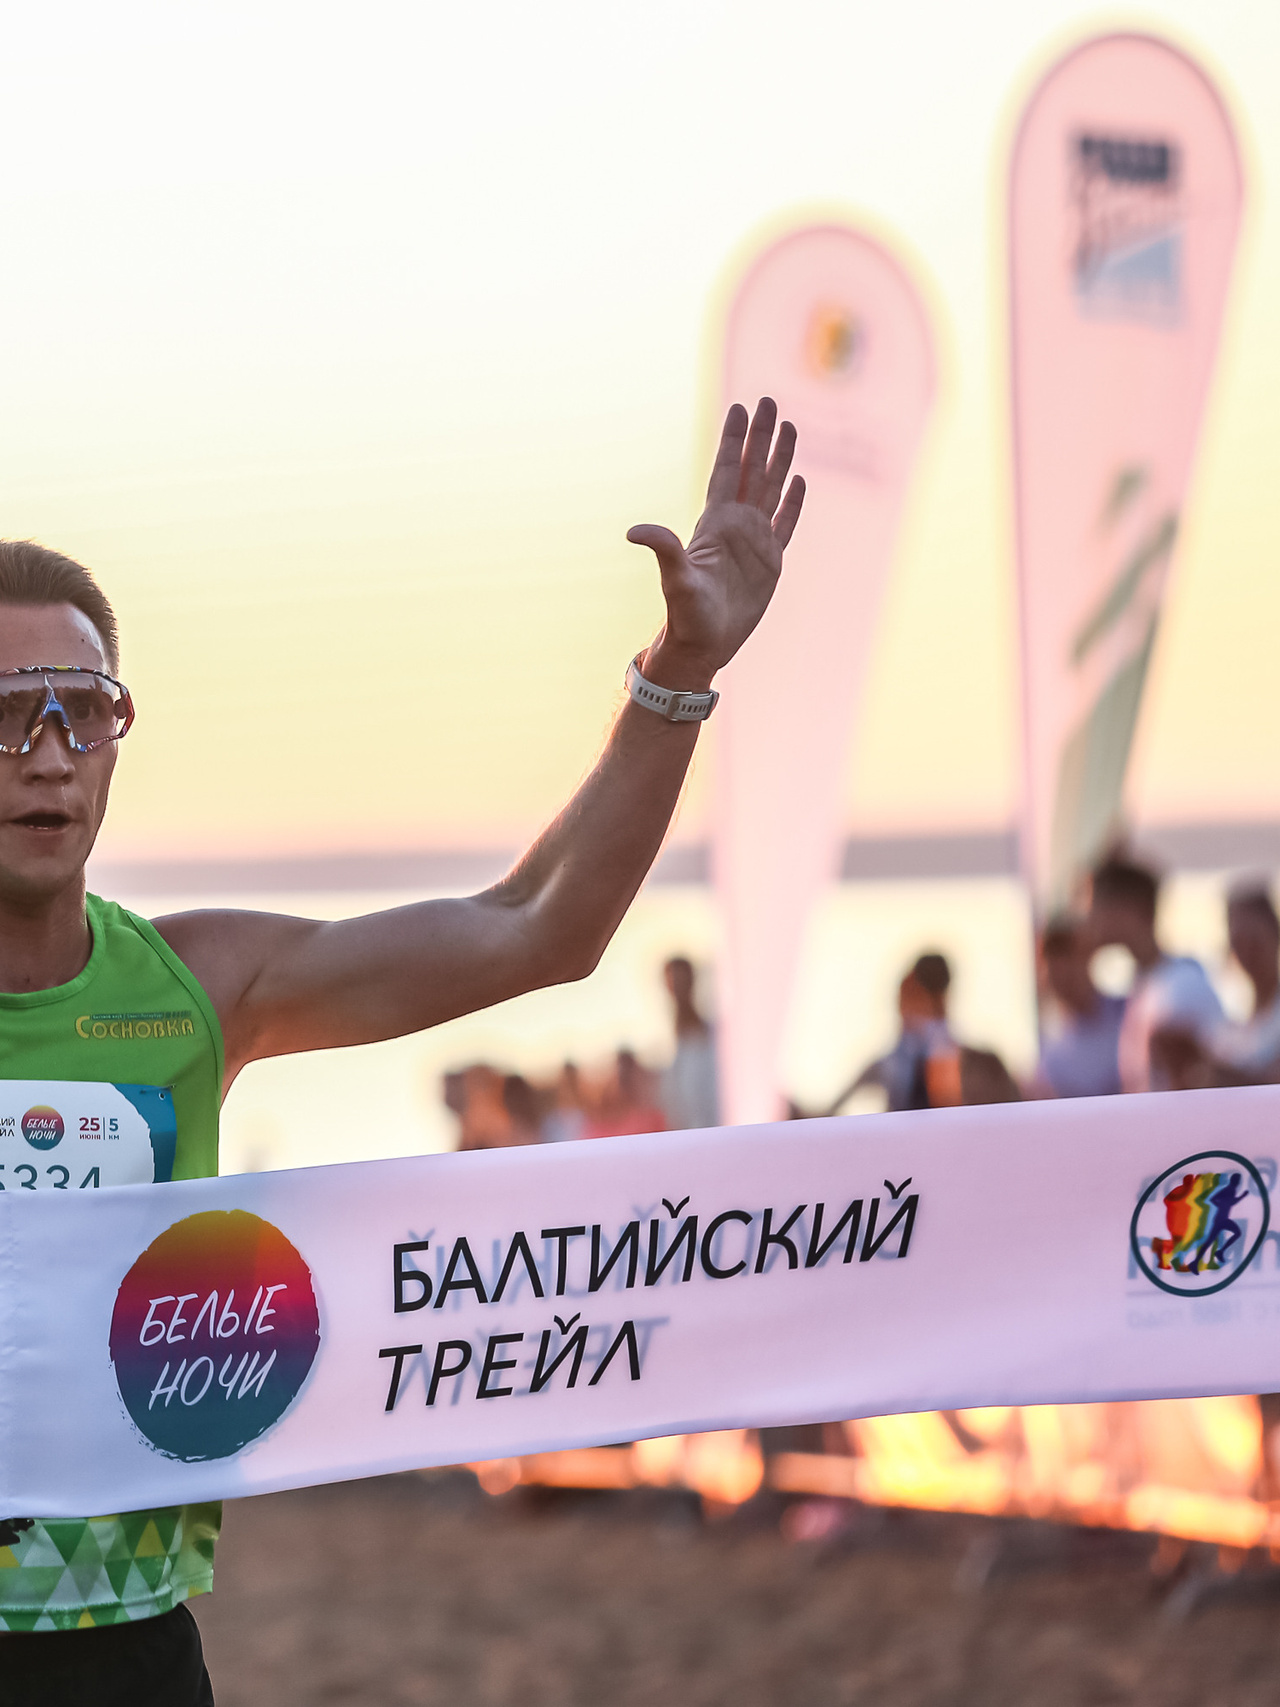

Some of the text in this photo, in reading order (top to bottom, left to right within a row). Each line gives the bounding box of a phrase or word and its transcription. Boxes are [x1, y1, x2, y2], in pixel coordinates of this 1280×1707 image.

[26, 1118, 58, 1129] БЕЛЫЕ
[28, 1130, 57, 1140] НОЧИ
[79, 1117, 101, 1132] 25
[109, 1118, 119, 1132] 5
[393, 1177, 920, 1314] БАЛТИЙСКИЙ
[139, 1284, 287, 1346] БЕЛЫЕ
[148, 1350, 277, 1411] НОЧИ
[378, 1312, 641, 1412] ТРЕЙЛ
